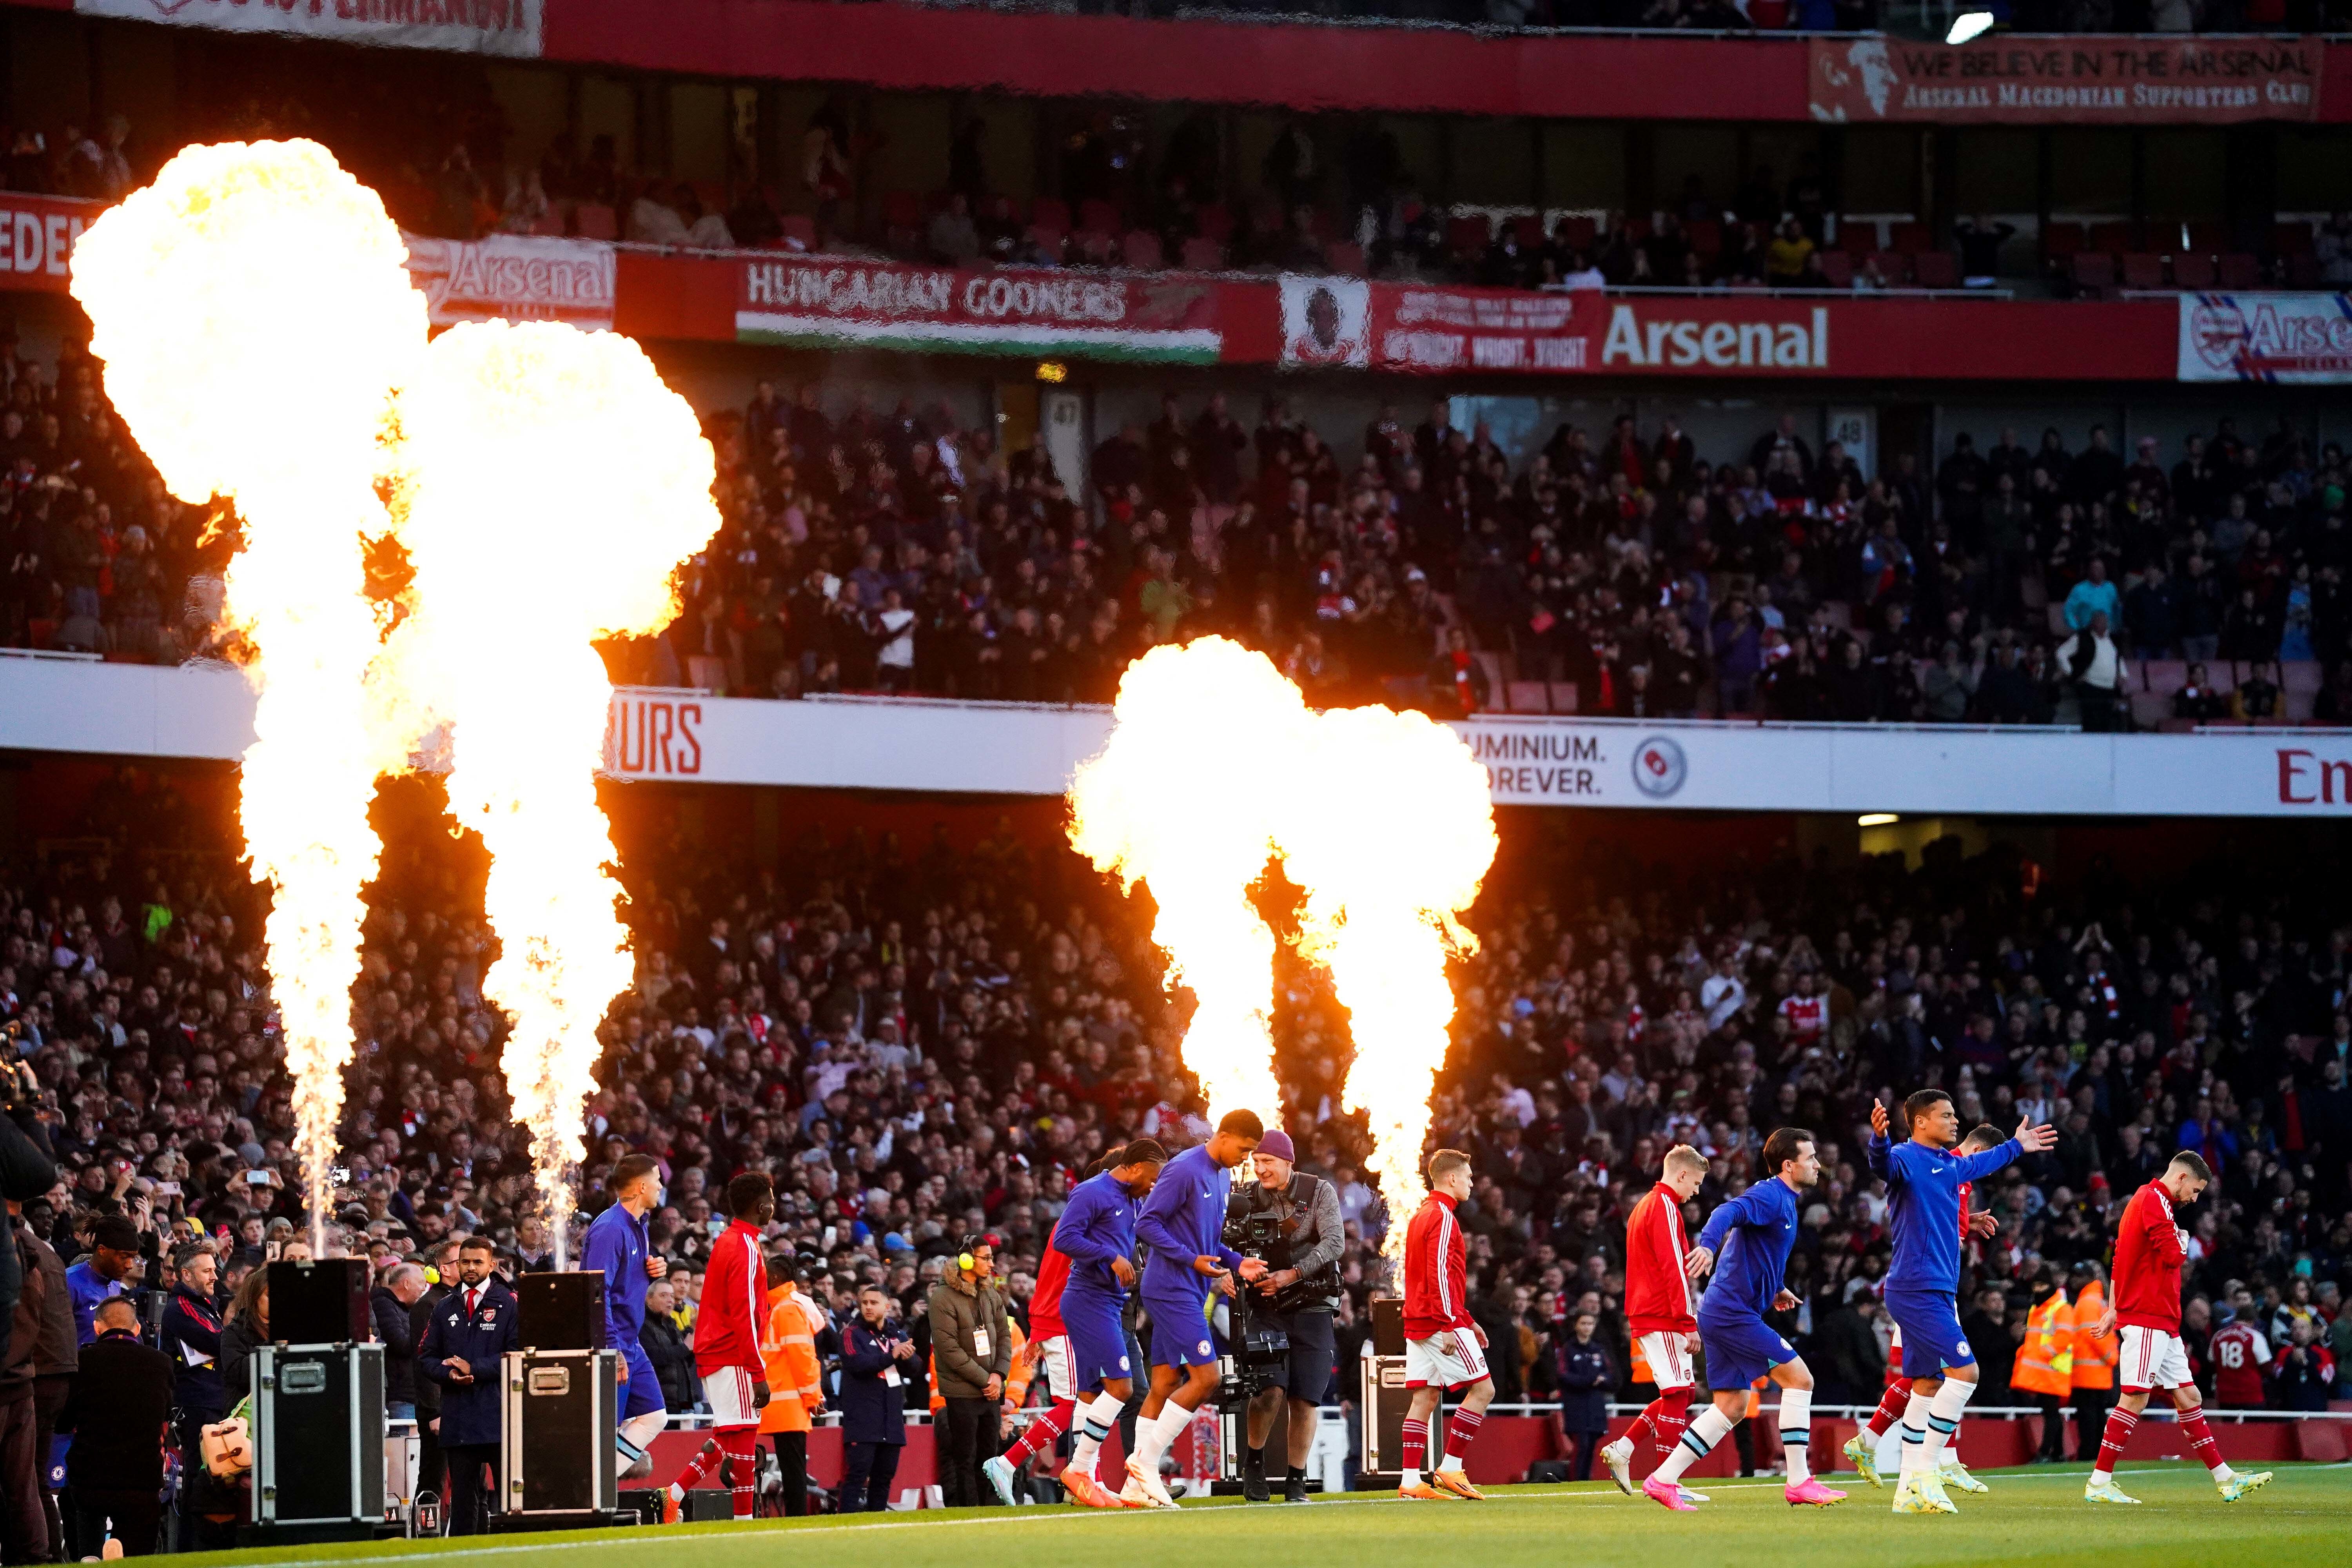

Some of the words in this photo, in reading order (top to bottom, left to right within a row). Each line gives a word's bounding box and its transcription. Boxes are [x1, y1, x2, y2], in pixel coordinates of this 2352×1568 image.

[1904, 49, 1951, 76] WE
[1961, 49, 2062, 77] BELIEVE
[2072, 49, 2101, 76] IN
[2113, 49, 2166, 76] THE
[2178, 48, 2313, 76] ARSENAL
[1998, 82, 2126, 107] MACEDONIAN
[2133, 82, 2258, 107] SUPPORTERS
[449, 241, 617, 301] Arsenal
[748, 262, 955, 314] HUNGARIAN
[960, 276, 1127, 322] GOONERS
[1602, 303, 1828, 368] Arsenal
[2219, 1340, 2244, 1369] 18
